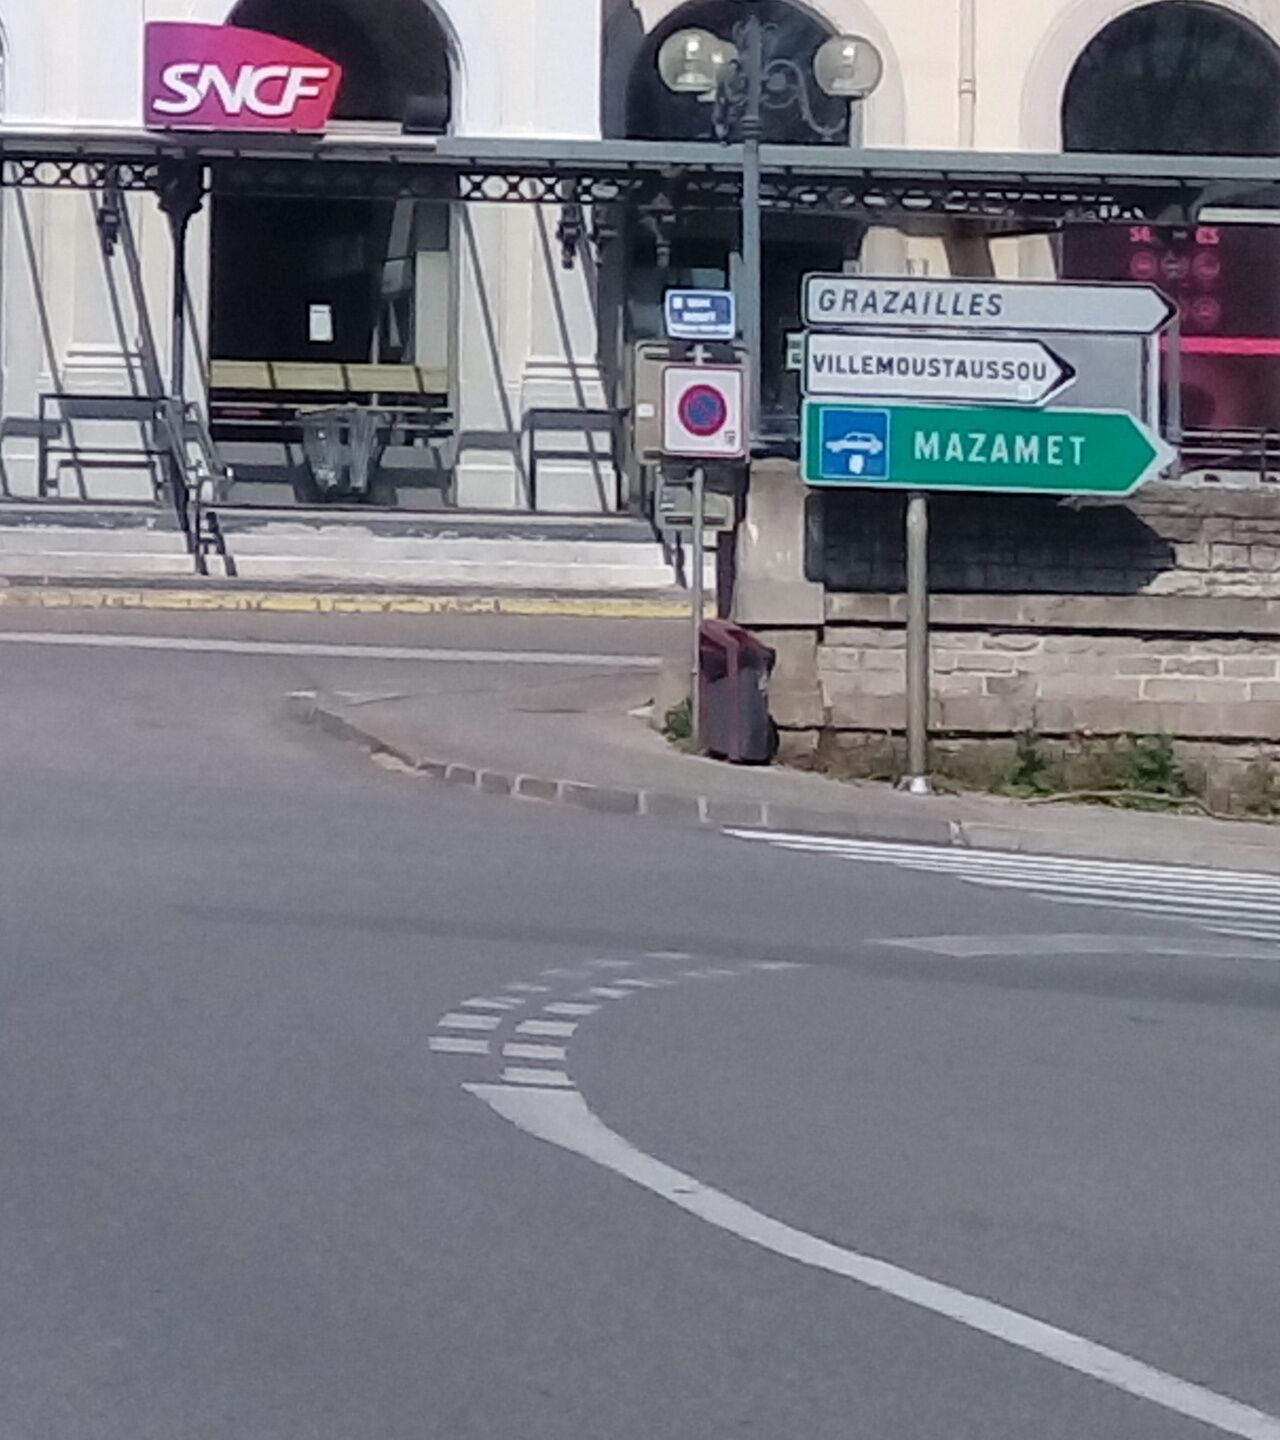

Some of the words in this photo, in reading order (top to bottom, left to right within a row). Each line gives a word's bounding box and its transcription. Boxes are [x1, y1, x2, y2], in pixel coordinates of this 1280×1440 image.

[152, 63, 330, 116] SNCF
[818, 288, 1004, 318] GRAZAILLES
[812, 353, 1048, 383] VILLEMOUSTAUSSOU
[913, 429, 1087, 467] MAZAMET
